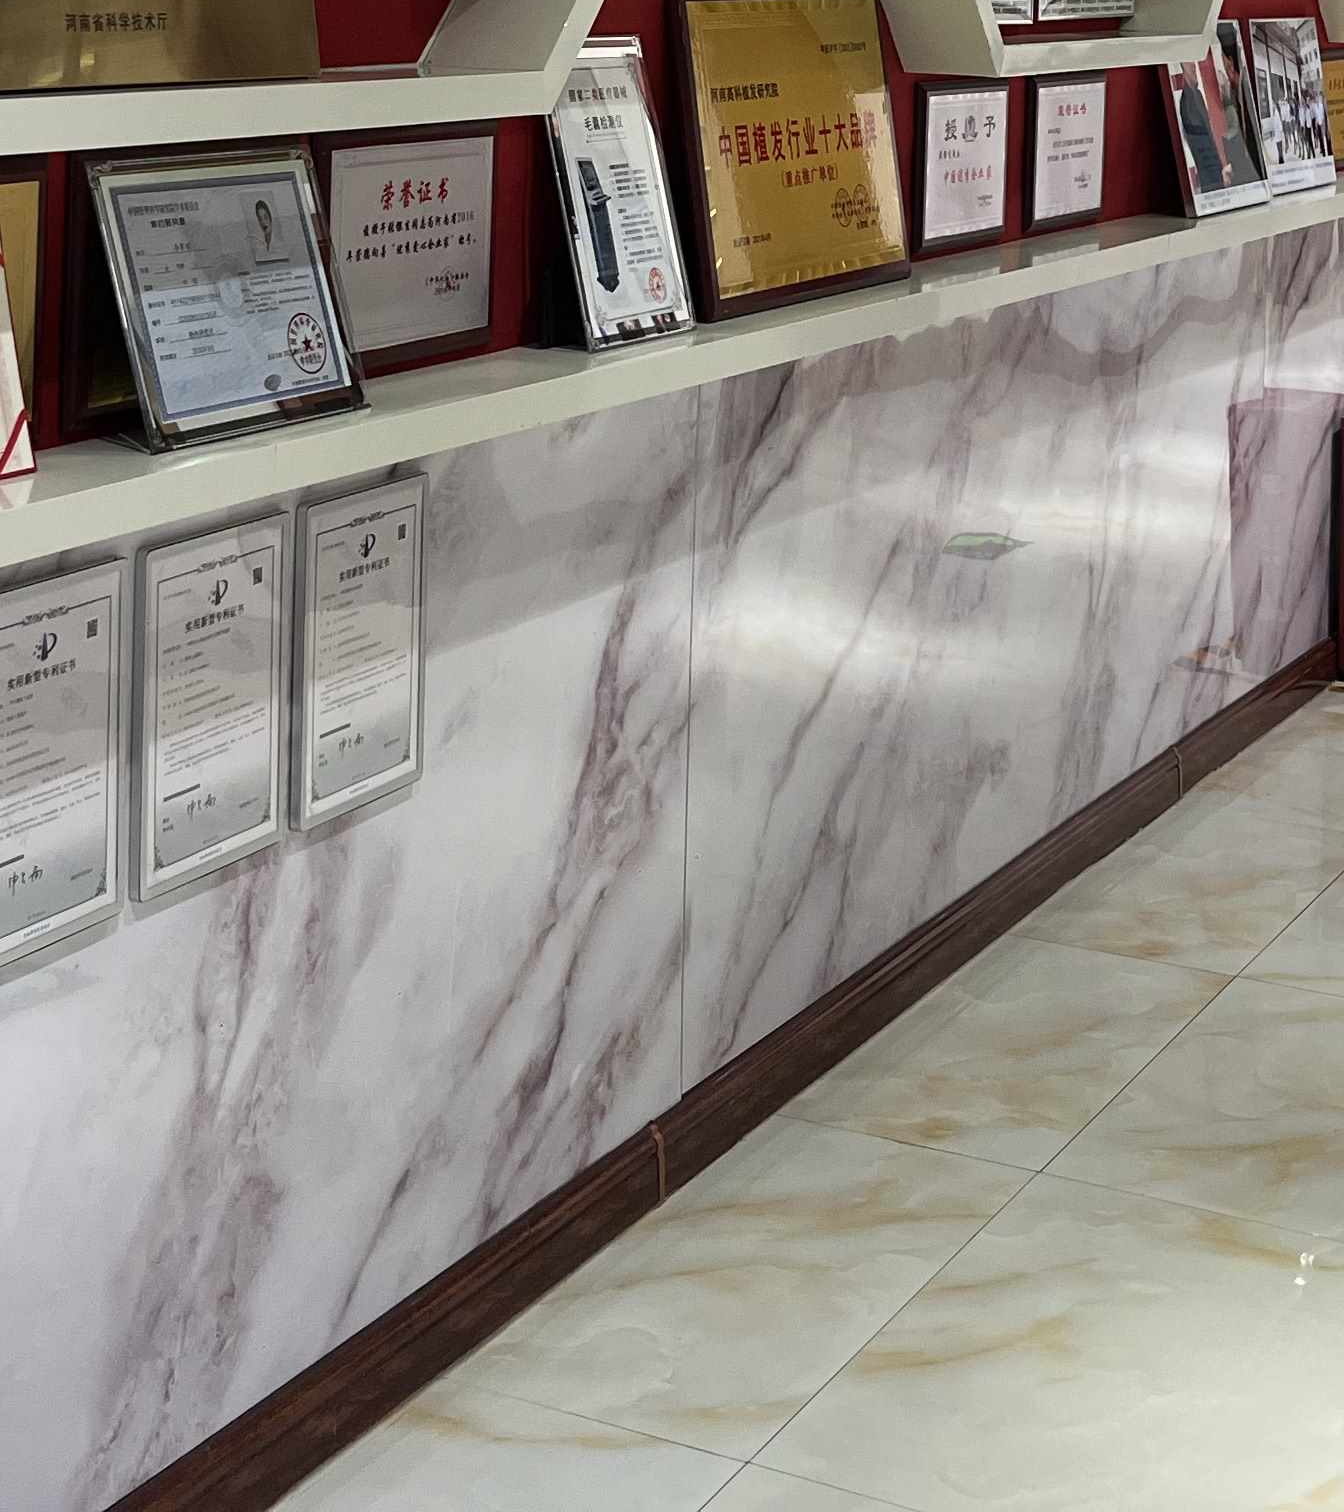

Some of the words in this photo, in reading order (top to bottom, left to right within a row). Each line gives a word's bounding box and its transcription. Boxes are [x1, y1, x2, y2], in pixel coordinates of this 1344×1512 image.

[64, 12, 169, 32] 河南省科学技术厅
[719, 109, 878, 169] 中国植发行业十大品牌
[380, 177, 450, 210] 荣誉证书
[185, 604, 245, 635] 实用新型专利证书
[7, 658, 77, 691] 实用新型专利证书
